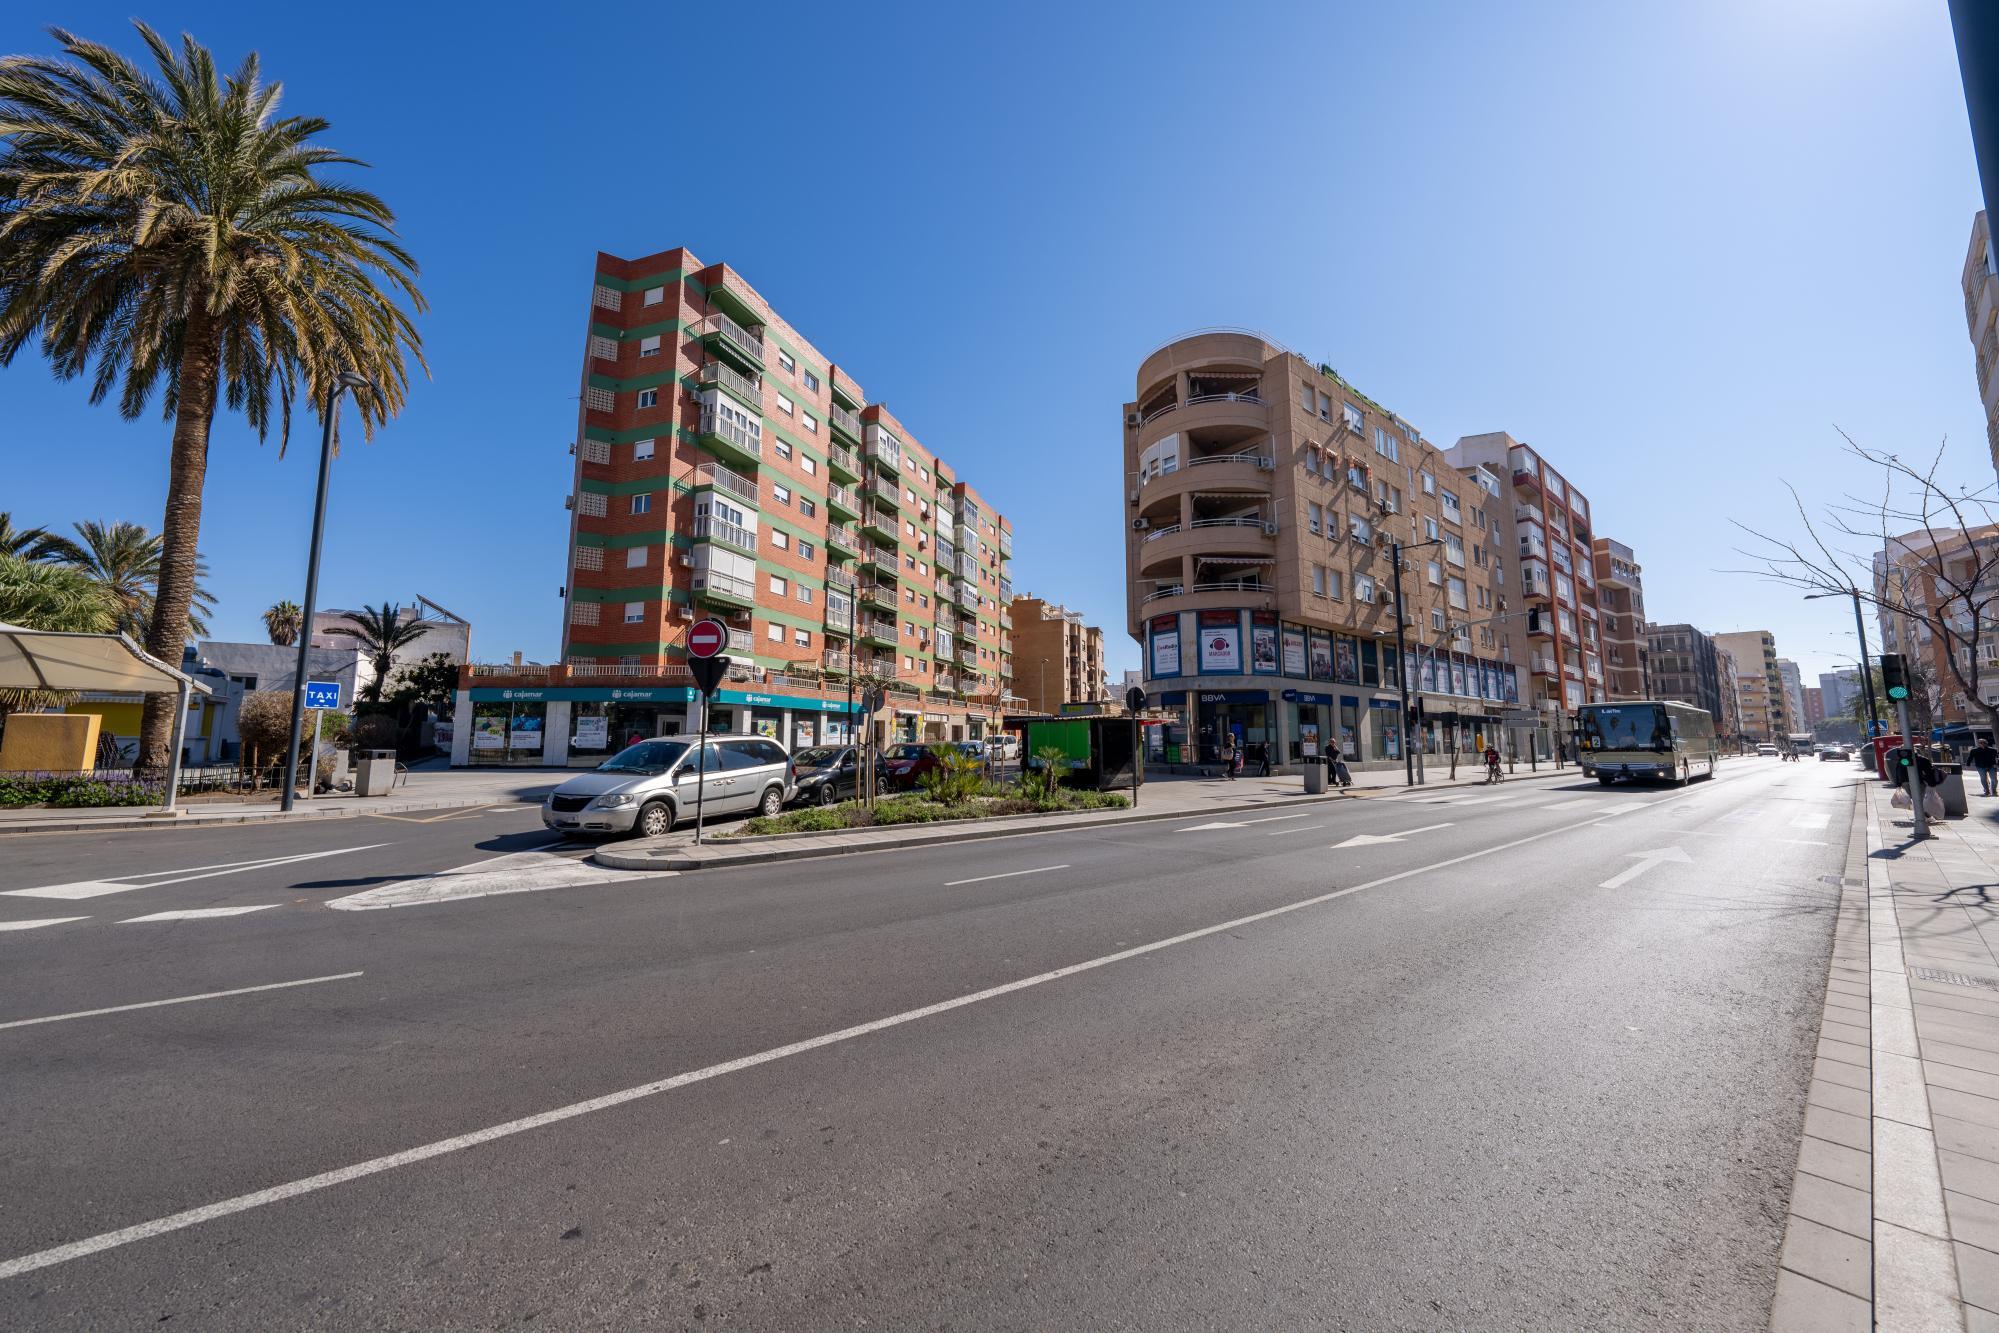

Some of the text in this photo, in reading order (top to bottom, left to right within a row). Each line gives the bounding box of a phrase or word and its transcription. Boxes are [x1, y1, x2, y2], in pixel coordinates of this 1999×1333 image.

[308, 691, 337, 700] TAXI
[514, 690, 543, 699] cajamar
[623, 690, 653, 699] cajamar
[1201, 694, 1226, 702] BBVA
